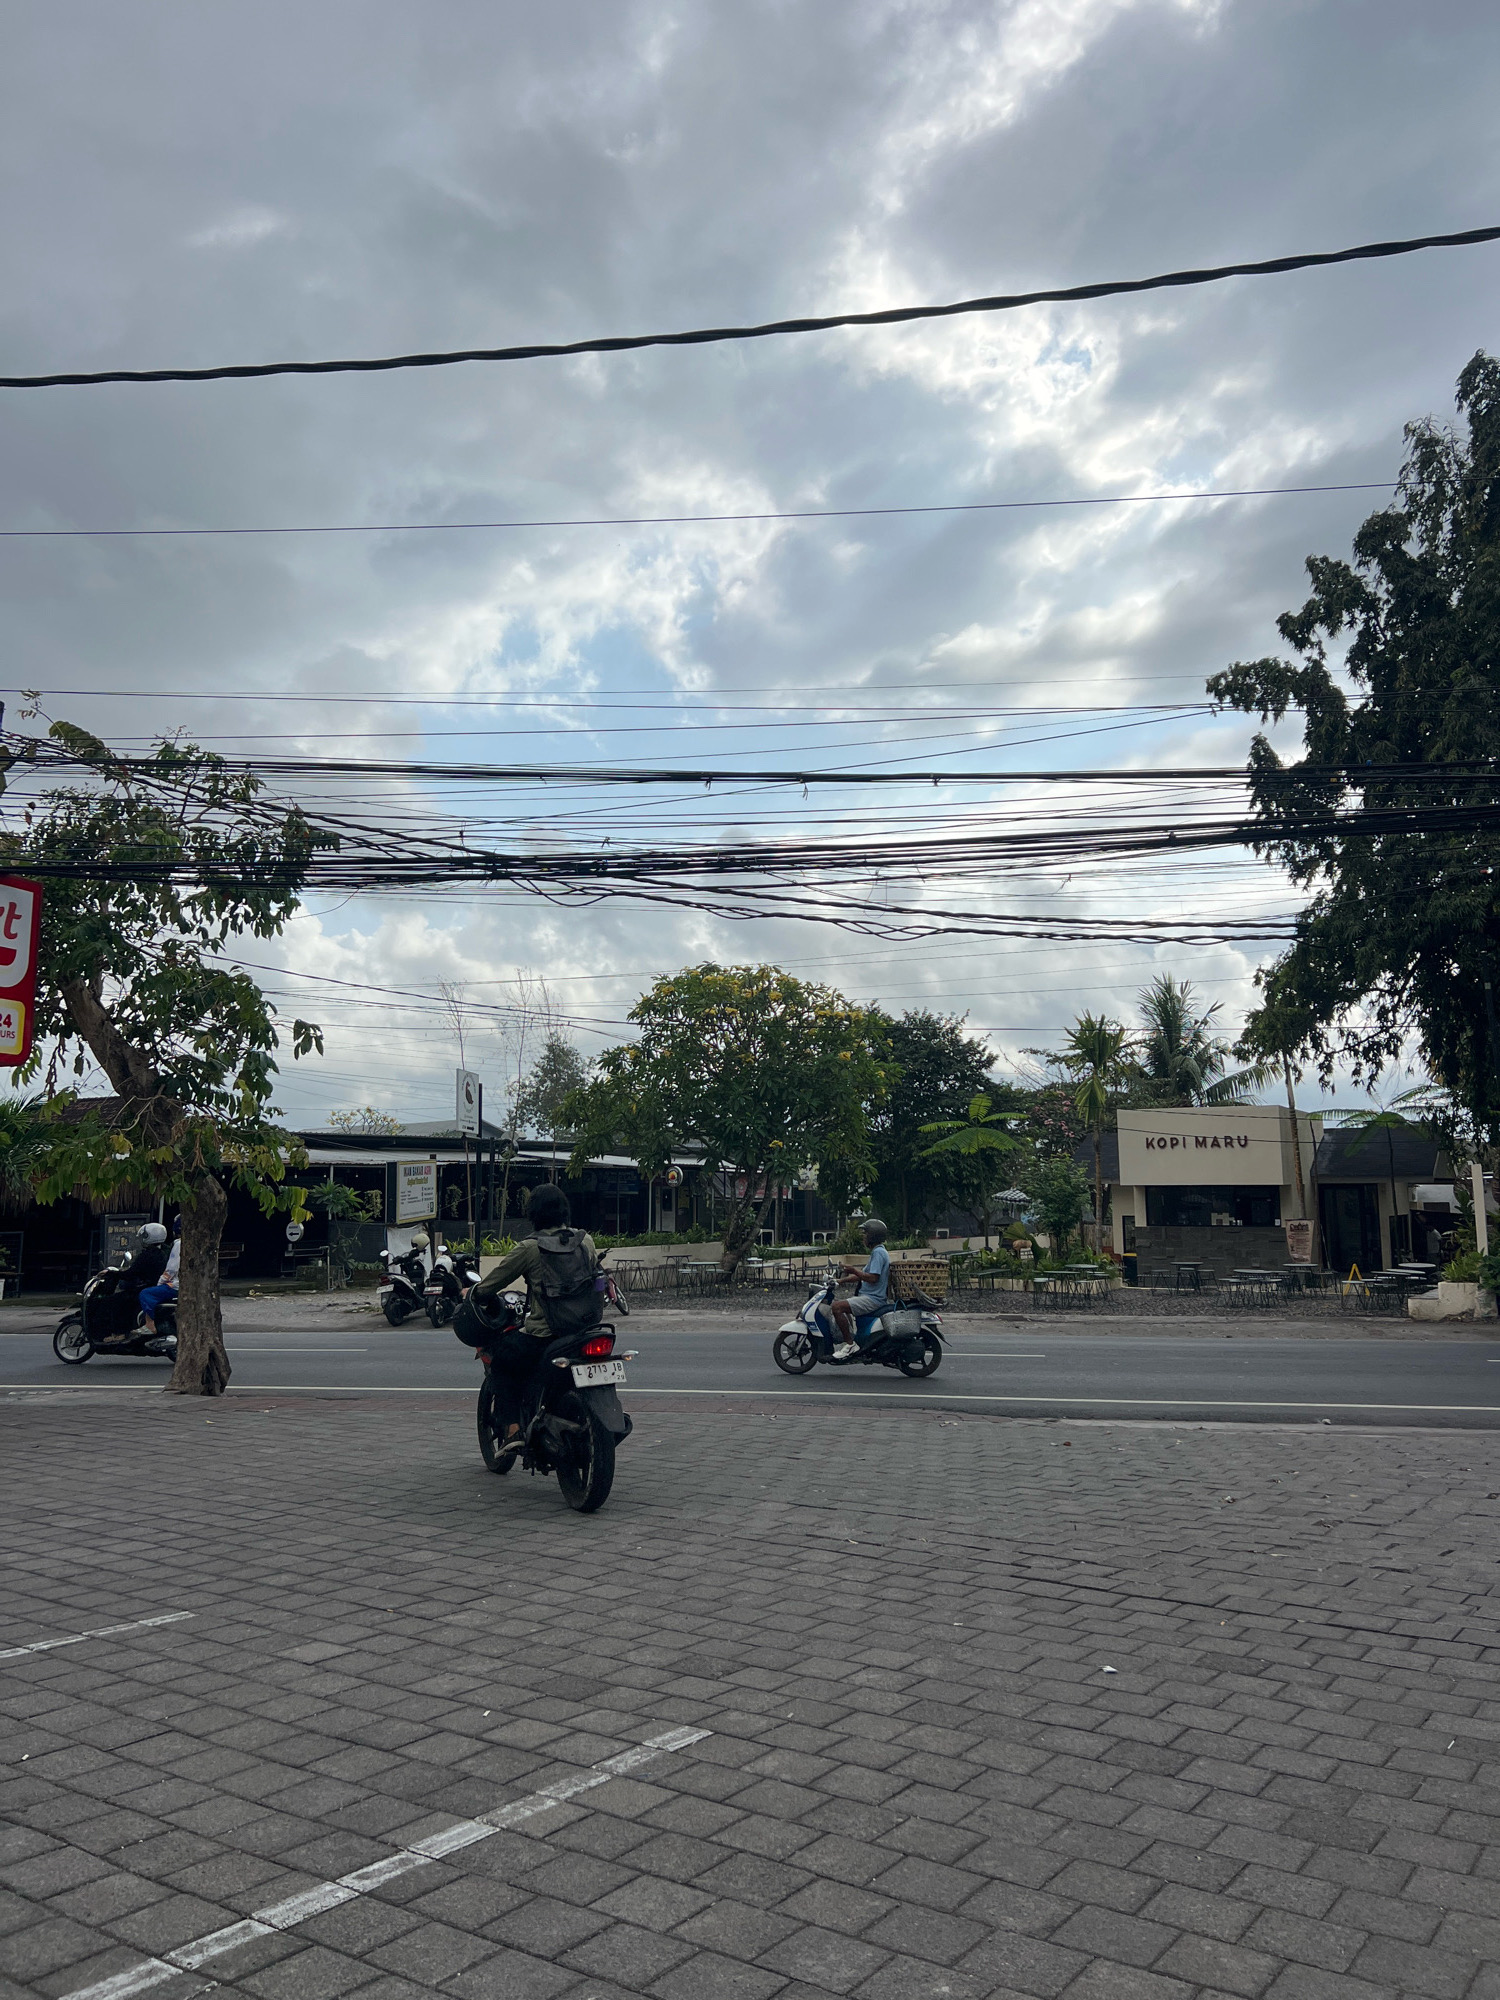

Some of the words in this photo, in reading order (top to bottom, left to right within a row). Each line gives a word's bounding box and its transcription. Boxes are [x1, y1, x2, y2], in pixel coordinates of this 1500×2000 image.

[1145, 1136, 1187, 1150] KOPI
[1194, 1135, 1248, 1149] MARU
[576, 1367, 583, 1376] L
